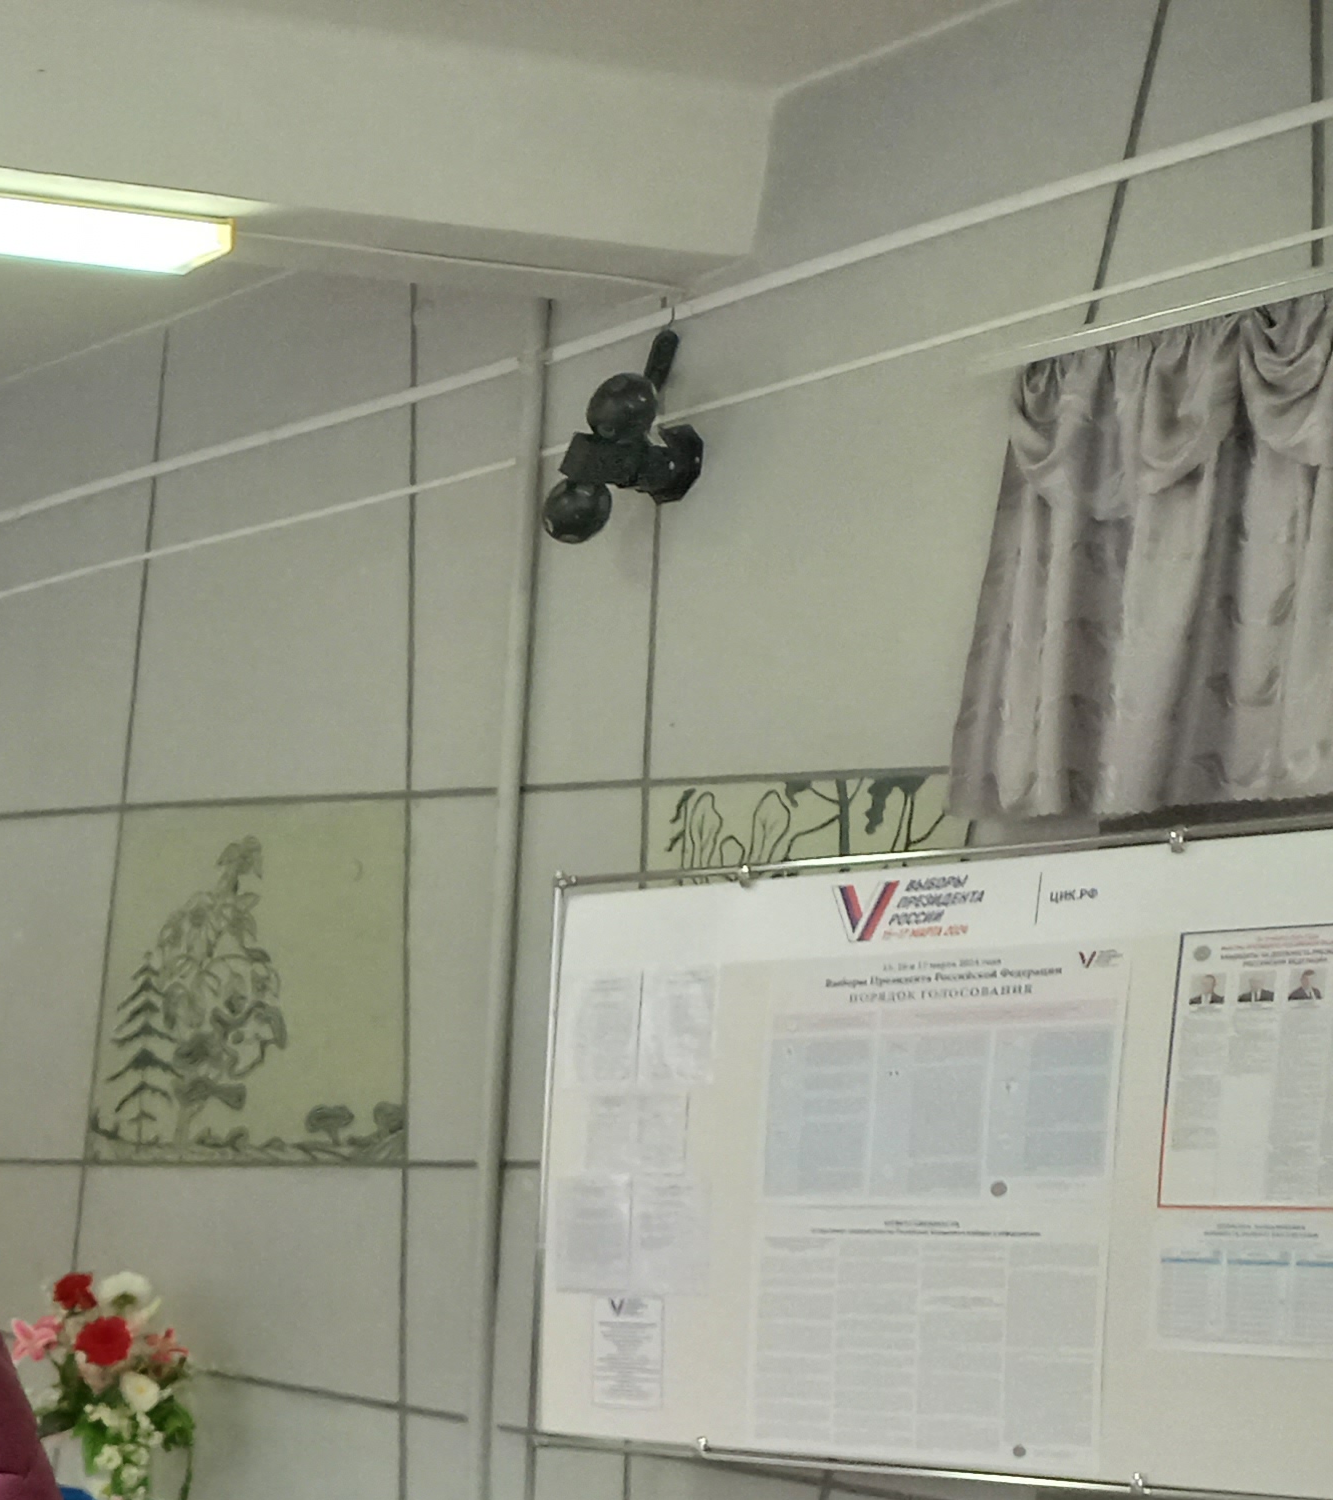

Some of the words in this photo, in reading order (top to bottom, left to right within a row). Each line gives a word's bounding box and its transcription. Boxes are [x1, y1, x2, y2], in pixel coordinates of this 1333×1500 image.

[905, 875, 968, 892] ВЫБОРЫ
[896, 890, 985, 909] ПРЕЗИДЕНТА
[1049, 888, 1099, 903] ЦИК.РФ
[888, 910, 945, 926] РОССИИ
